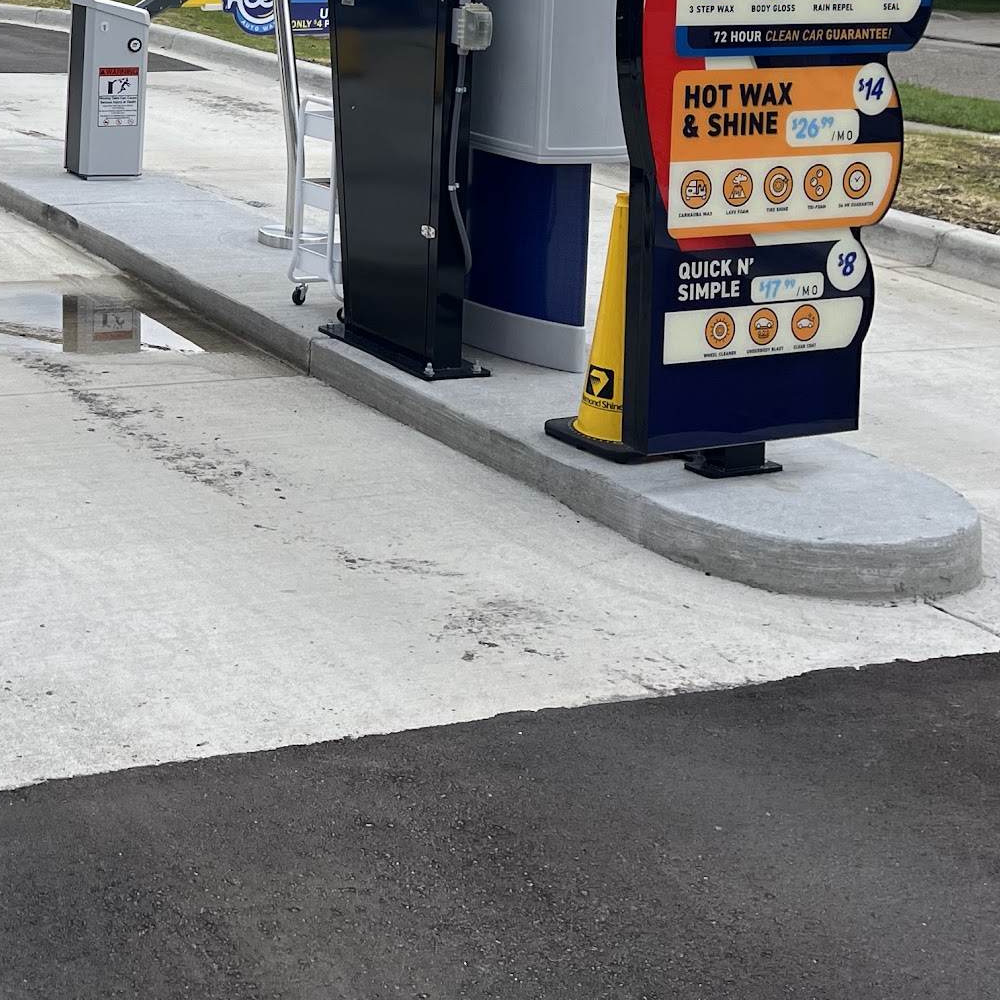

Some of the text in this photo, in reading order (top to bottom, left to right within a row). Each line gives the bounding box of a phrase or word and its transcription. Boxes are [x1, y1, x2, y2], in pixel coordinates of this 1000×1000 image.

[689, 5, 735, 14] 3 STEP WAX
[751, 4, 796, 13] BODY GLOSS
[813, 3, 854, 12] RAIN REPEL
[883, 2, 900, 11] SEAL
[714, 26, 892, 43] 72 HOUR CLEAN CAR GUARANTEE!
[684, 82, 793, 109] HOT WAX
[858, 77, 885, 101] $14
[682, 111, 778, 138] & SHINE
[678, 257, 755, 280] QUICK N'
[838, 251, 857, 277] $8
[678, 280, 741, 302] SIMPLE
